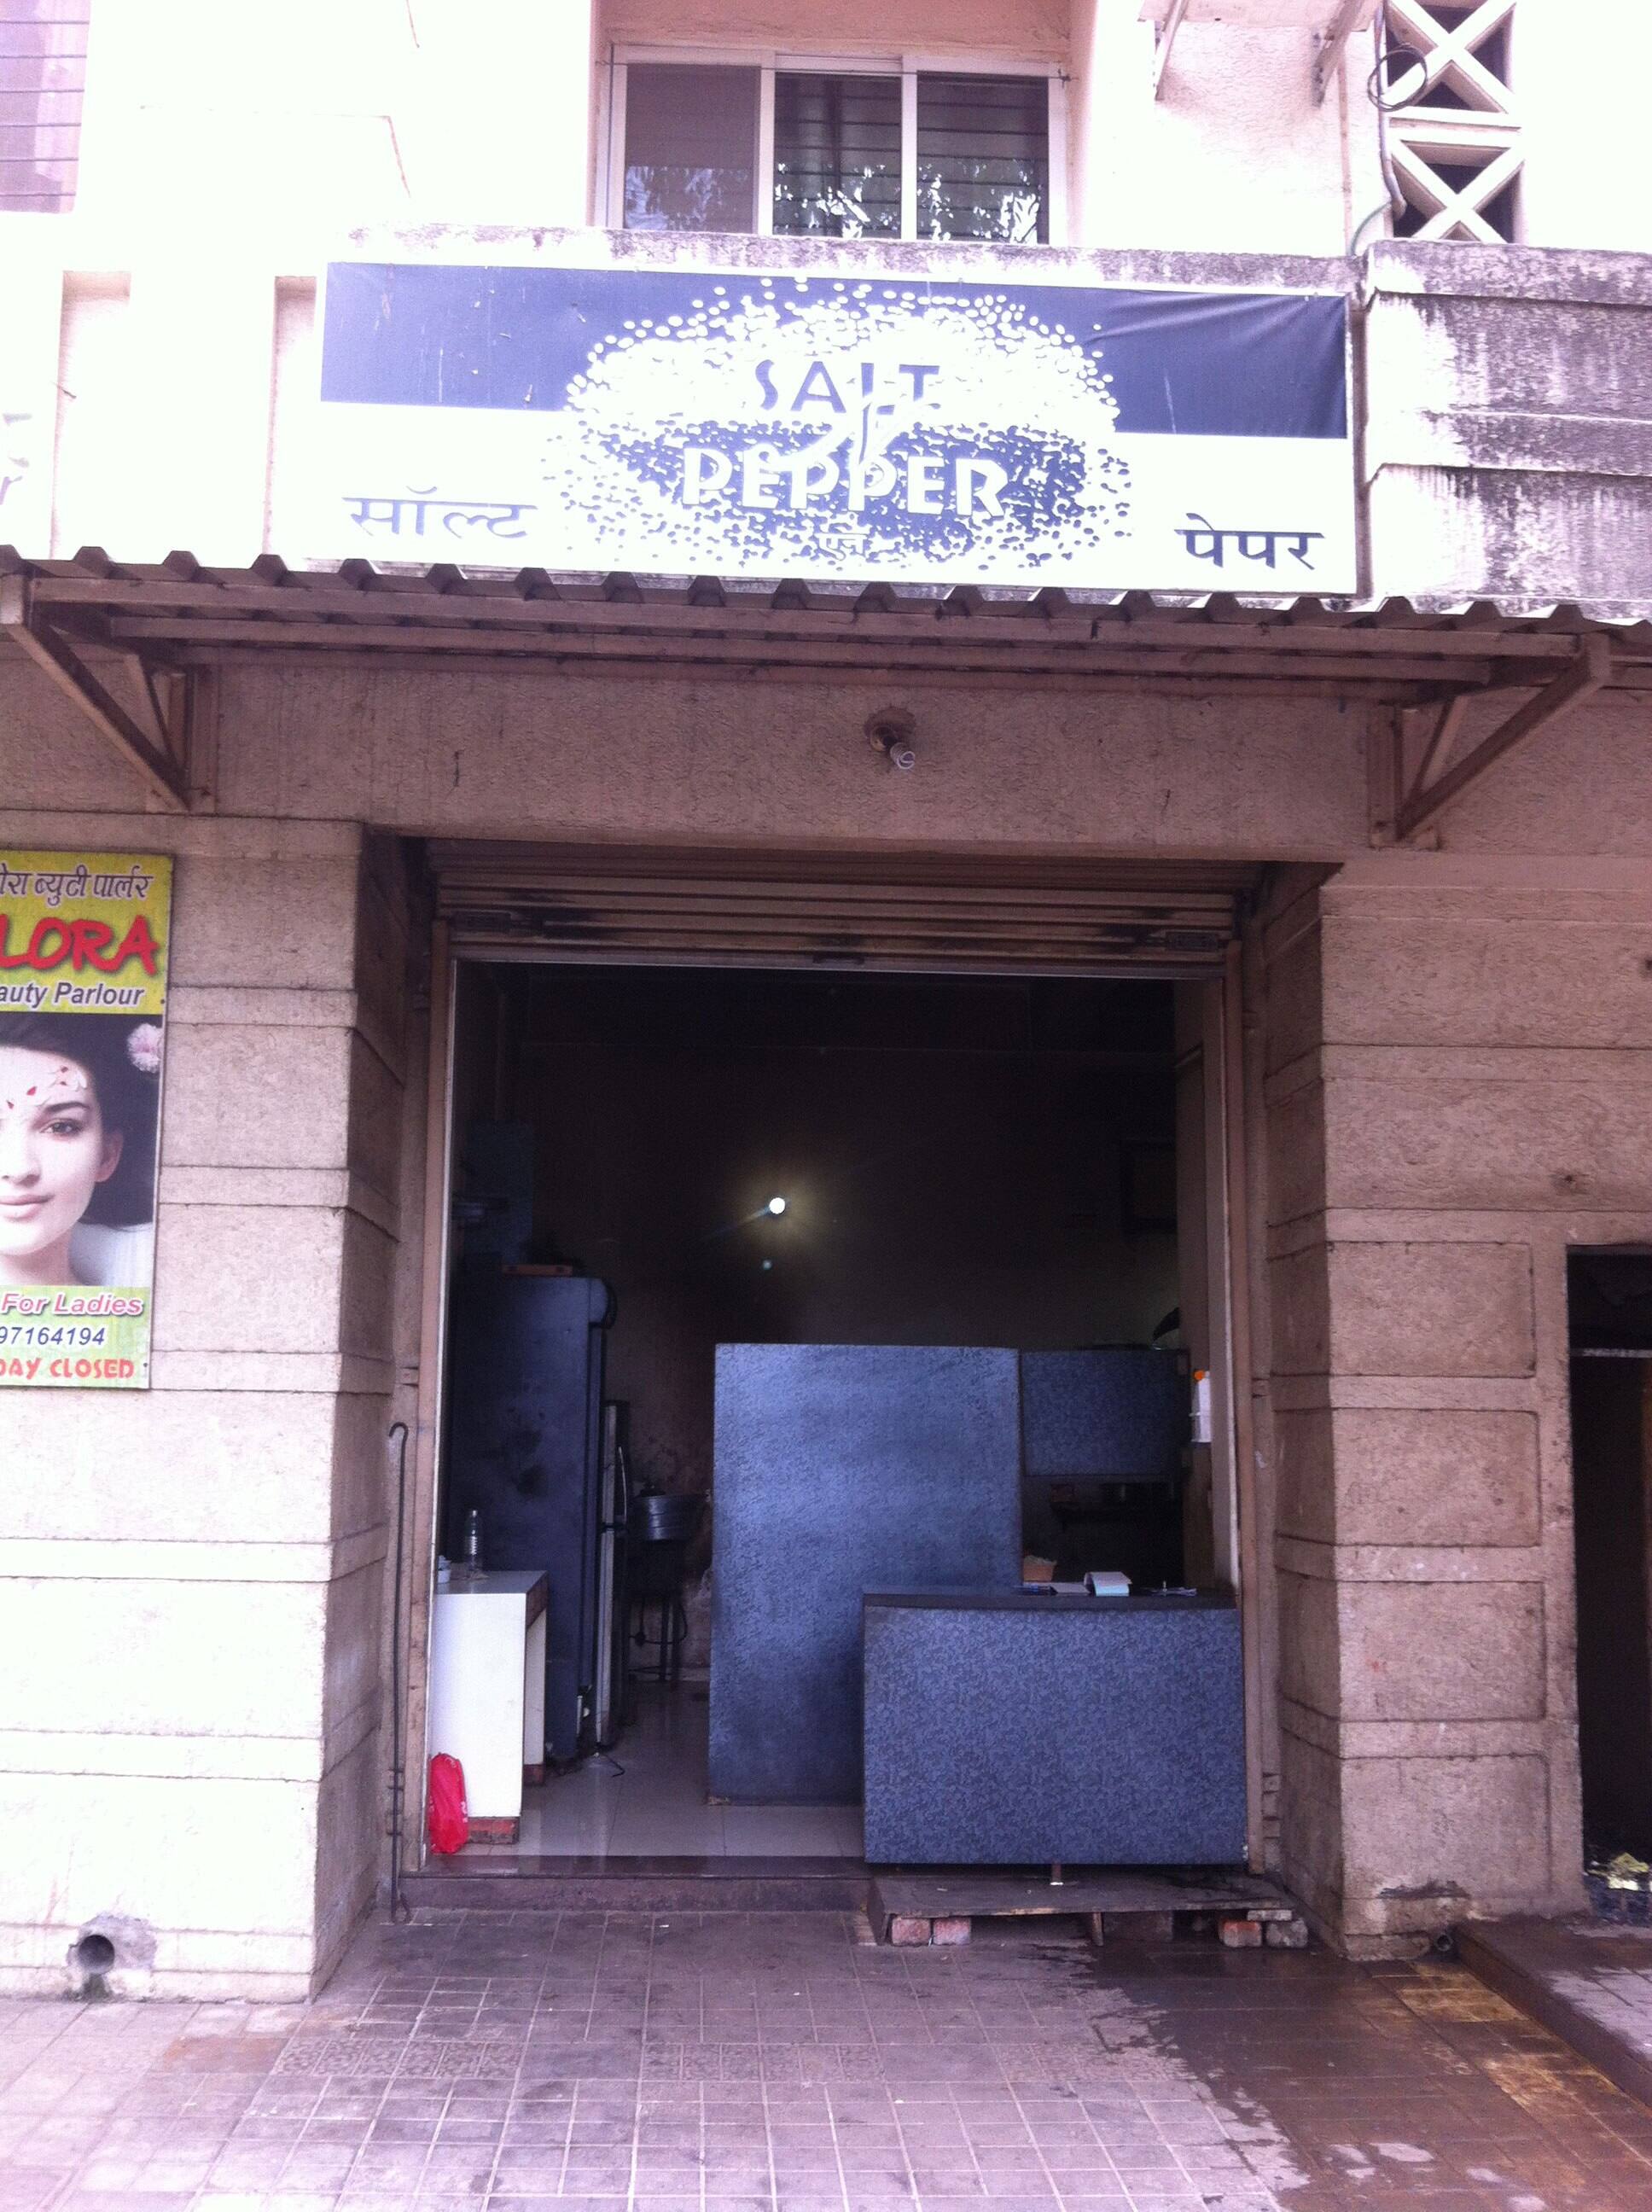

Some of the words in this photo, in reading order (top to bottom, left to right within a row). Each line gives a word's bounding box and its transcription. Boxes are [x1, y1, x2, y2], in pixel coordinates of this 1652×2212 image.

[755, 359, 939, 415] SALT
[682, 444, 1009, 517] PEPPER
[341, 485, 538, 538] सॉल्ट
[1173, 512, 1325, 570] पेपर
[94, 865, 154, 898] पार्लर
[54, 981, 145, 1005] Parlour
[1, 1293, 49, 1314] For
[54, 1294, 143, 1315] Ladies
[49, 1358, 135, 1379] CLOSED
